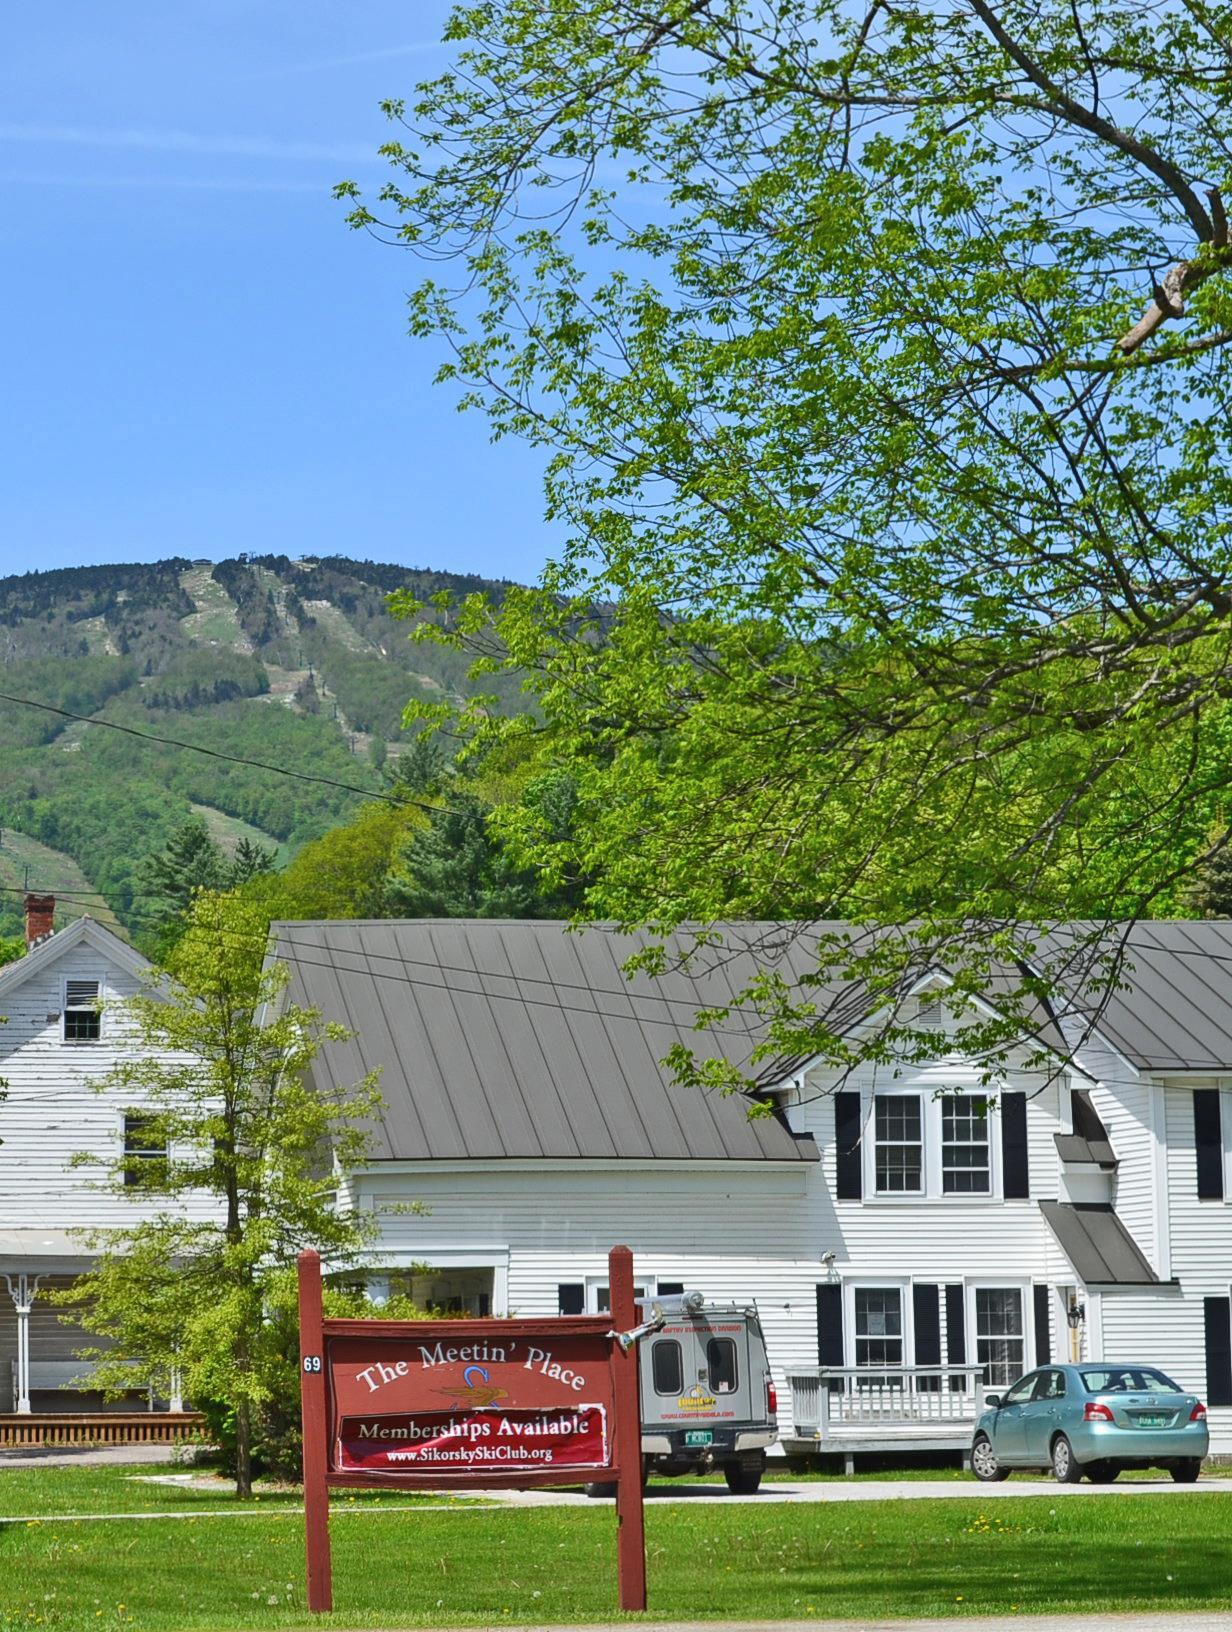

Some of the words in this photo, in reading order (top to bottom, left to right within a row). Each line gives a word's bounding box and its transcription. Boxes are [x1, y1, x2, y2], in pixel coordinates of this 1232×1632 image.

[303, 1356, 321, 1372] 69
[355, 1360, 410, 1393] The
[417, 1340, 516, 1369] Meetin'
[523, 1346, 586, 1391] Place
[358, 1418, 491, 1442] Memberships
[497, 1415, 589, 1436] Available
[386, 1445, 553, 1463] www.SikorskySkiClub.org
